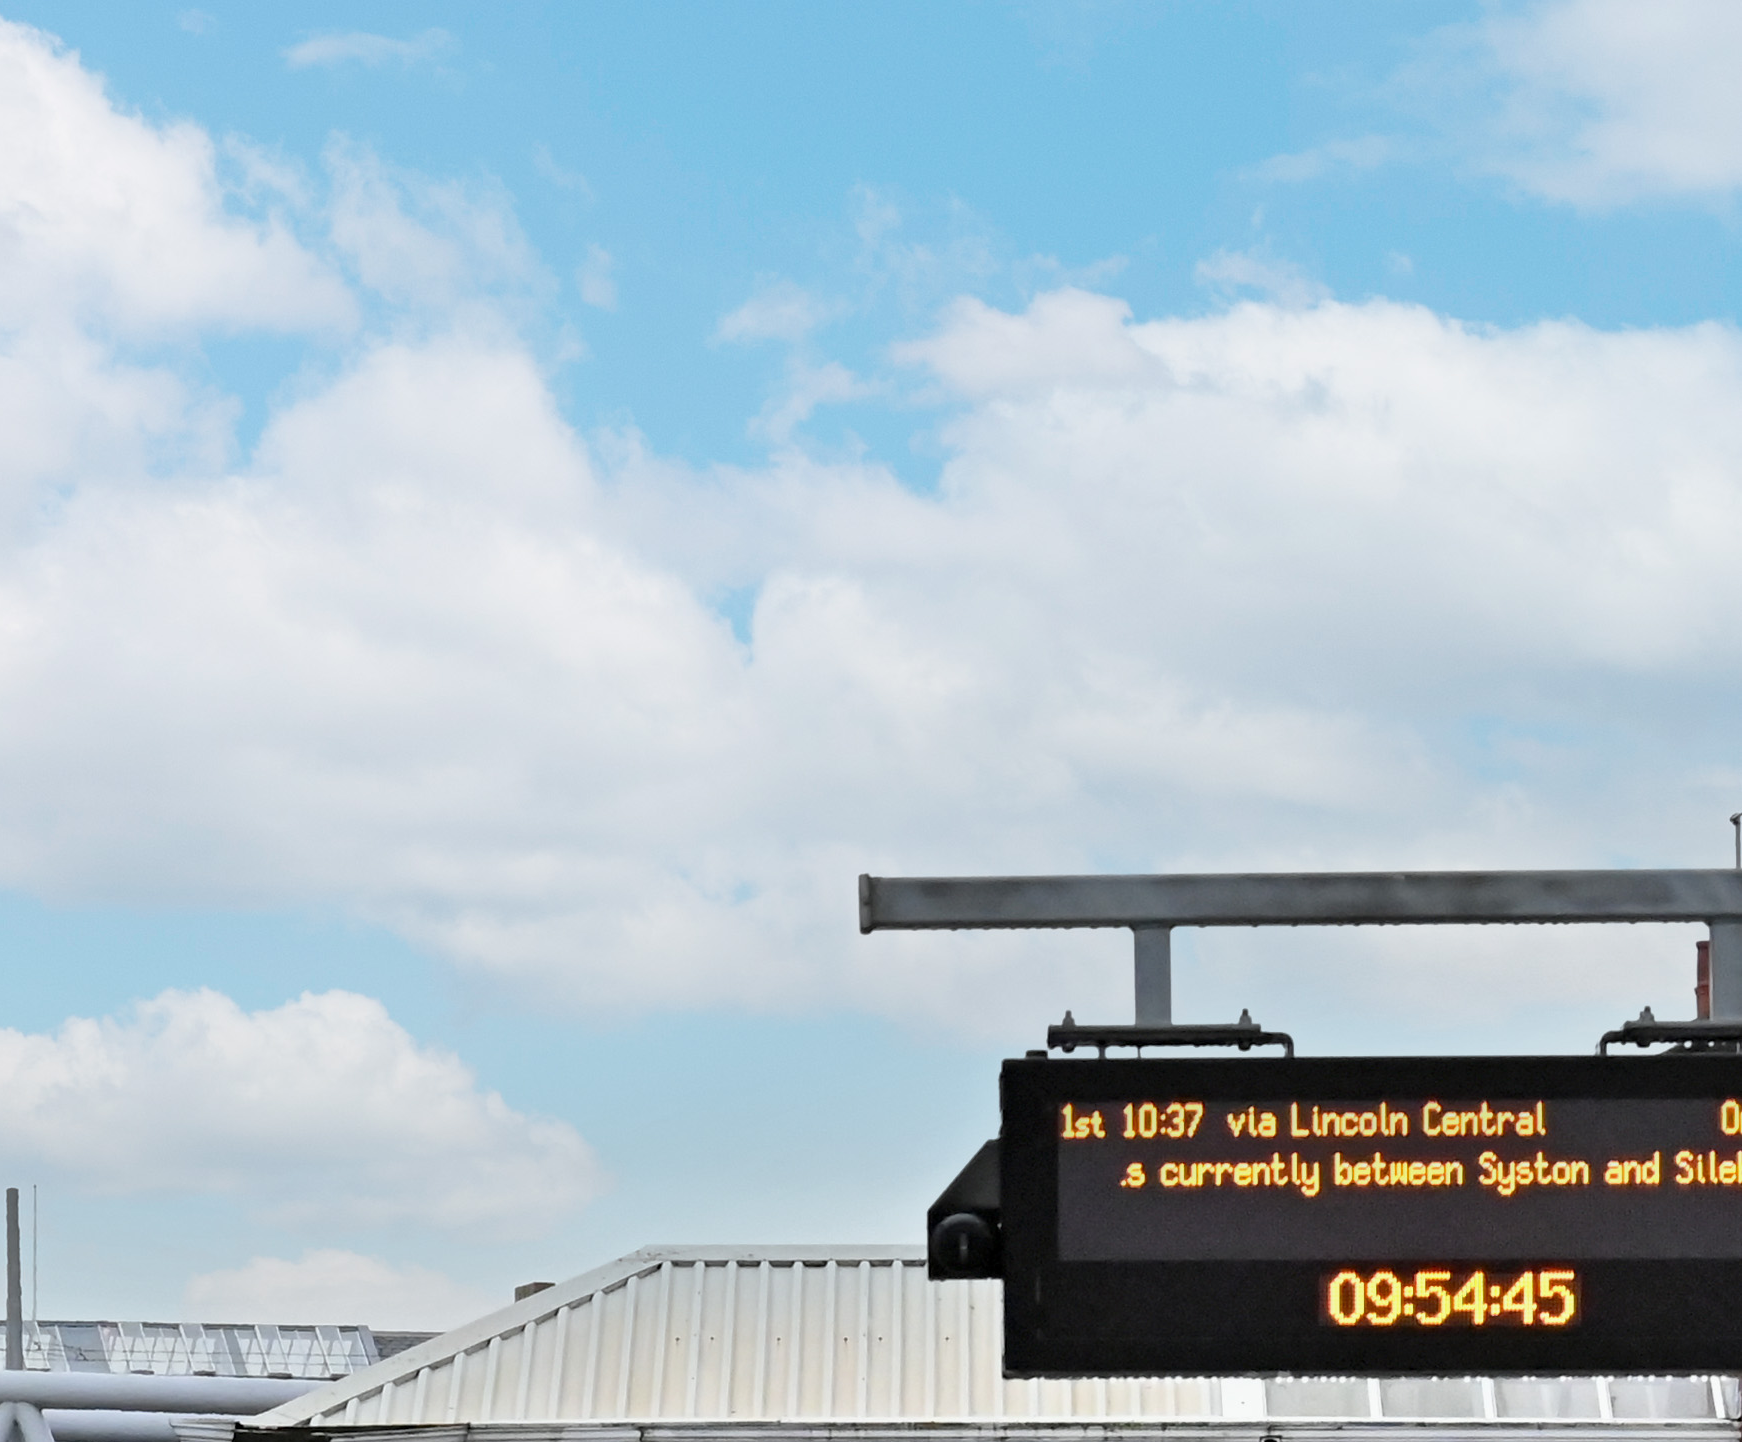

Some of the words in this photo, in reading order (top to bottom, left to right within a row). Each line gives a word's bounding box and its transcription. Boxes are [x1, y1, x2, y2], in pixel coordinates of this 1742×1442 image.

[1061, 1103, 1105, 1138] 1st
[1123, 1102, 1203, 1138] 10:37
[1227, 1106, 1277, 1138] via
[1290, 1101, 1409, 1137] Lincoln
[1422, 1100, 1547, 1137] Central
[1720, 1100, 1742, 1136] O
[1160, 1152, 1320, 1196] currently
[1333, 1152, 1463, 1186] between
[1478, 1151, 1589, 1196] Syston
[1605, 1151, 1660, 1185] and
[1327, 1270, 1577, 1326] 09:54:45
